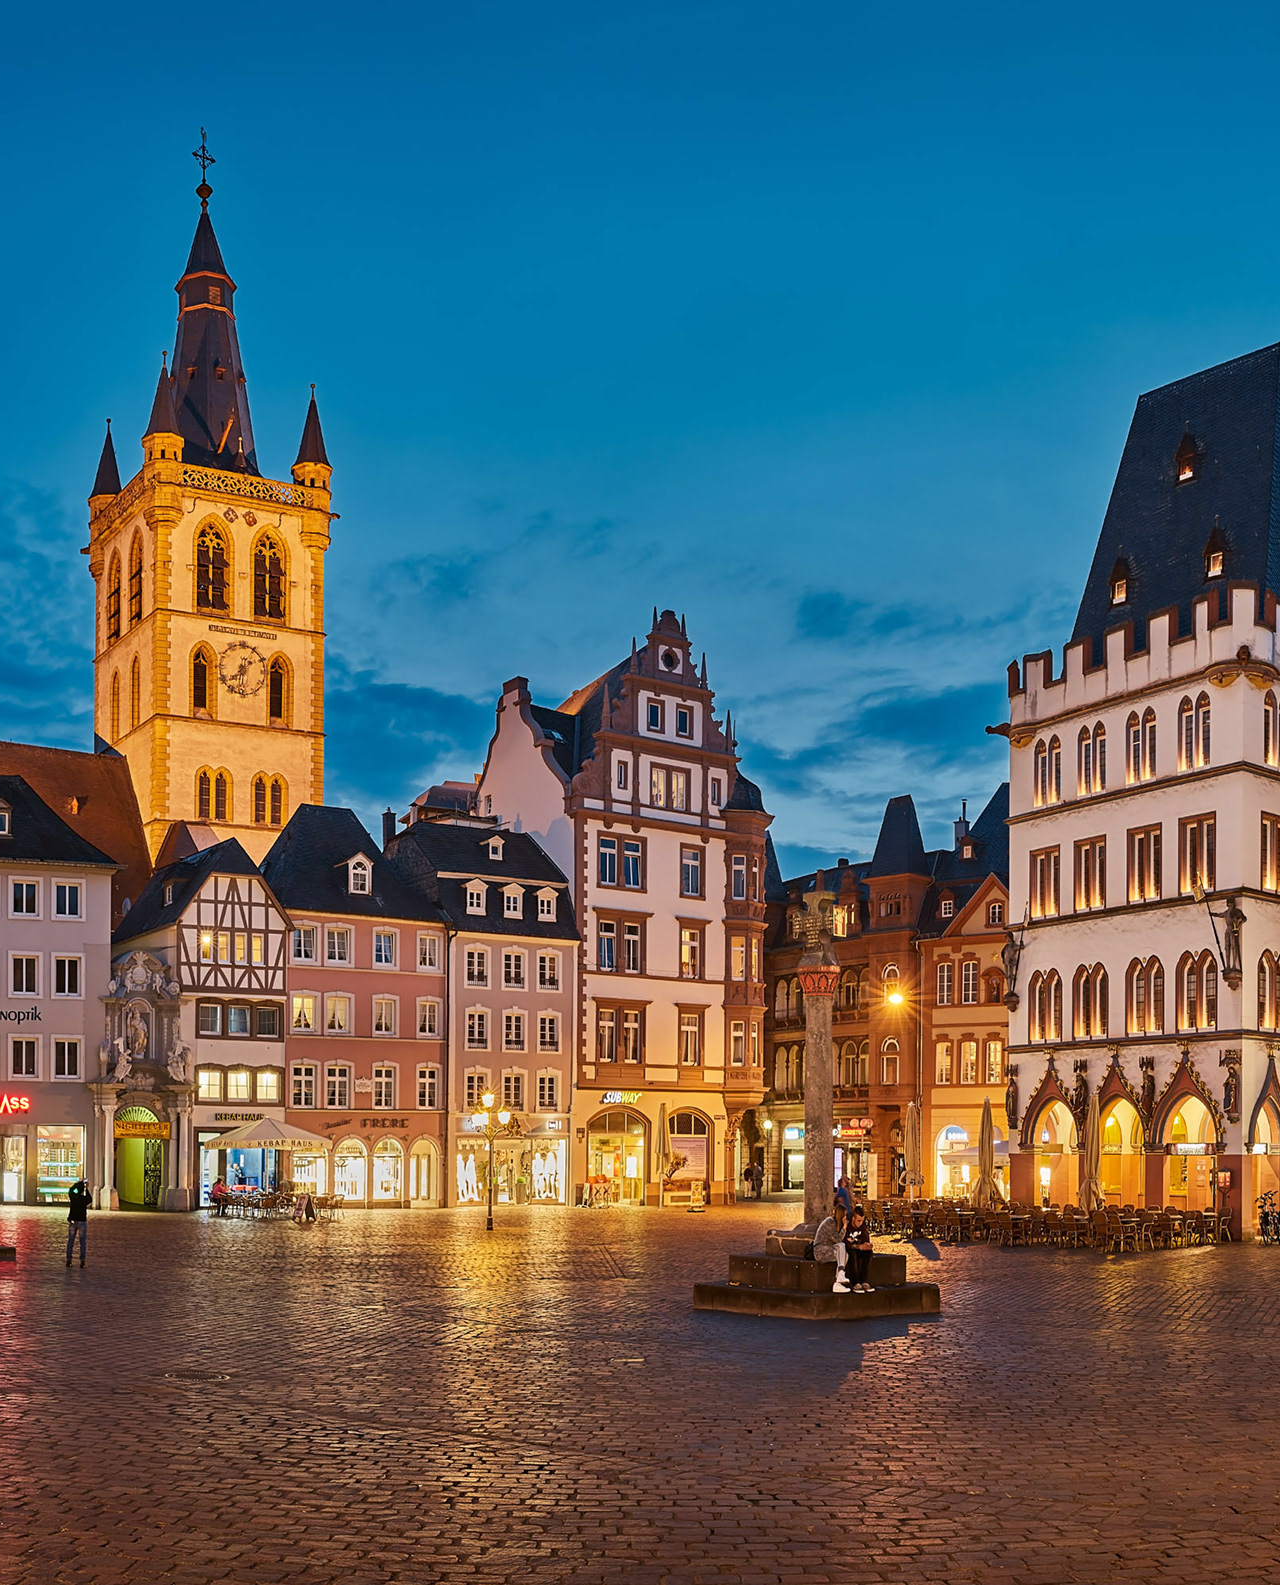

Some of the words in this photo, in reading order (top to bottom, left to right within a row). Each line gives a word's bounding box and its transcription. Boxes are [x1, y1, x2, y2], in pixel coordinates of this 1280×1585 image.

[603, 1091, 642, 1104] SUBWAY
[115, 1122, 169, 1131] NIGHTFEVER
[257, 1139, 286, 1148] KEBAP
